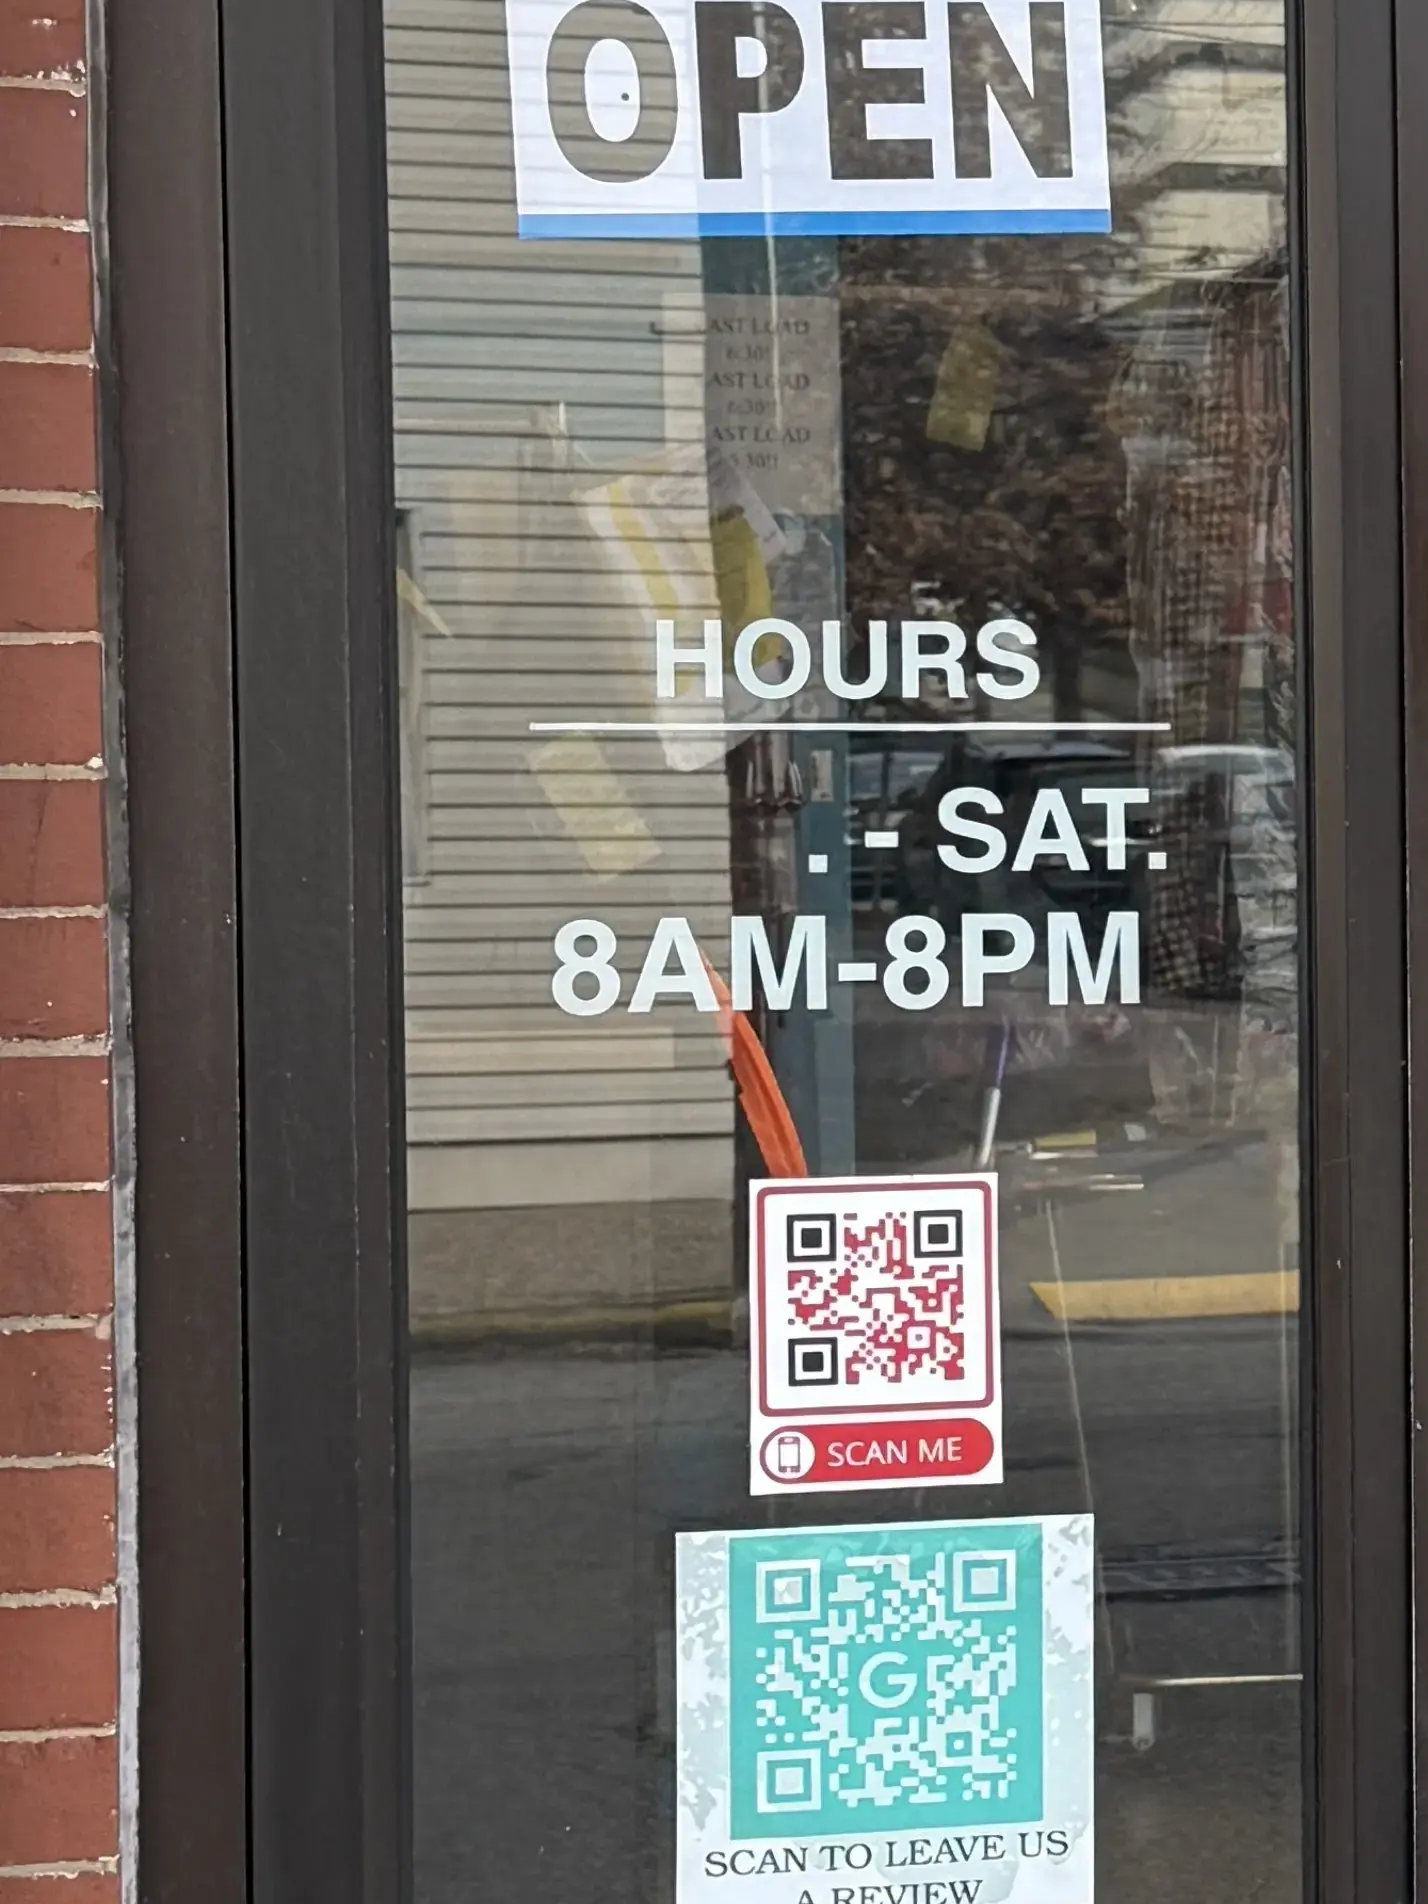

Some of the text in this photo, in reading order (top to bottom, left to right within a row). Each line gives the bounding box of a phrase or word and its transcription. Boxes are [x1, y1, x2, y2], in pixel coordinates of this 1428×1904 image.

[655, 618, 1040, 700] HOURS
[937, 787, 1168, 874] SAT.
[551, 911, 1141, 1016] 8AM-8PM
[827, 1437, 962, 1467] SCAN ME
[705, 1830, 1069, 1877] SCAN TO LEAVE US
